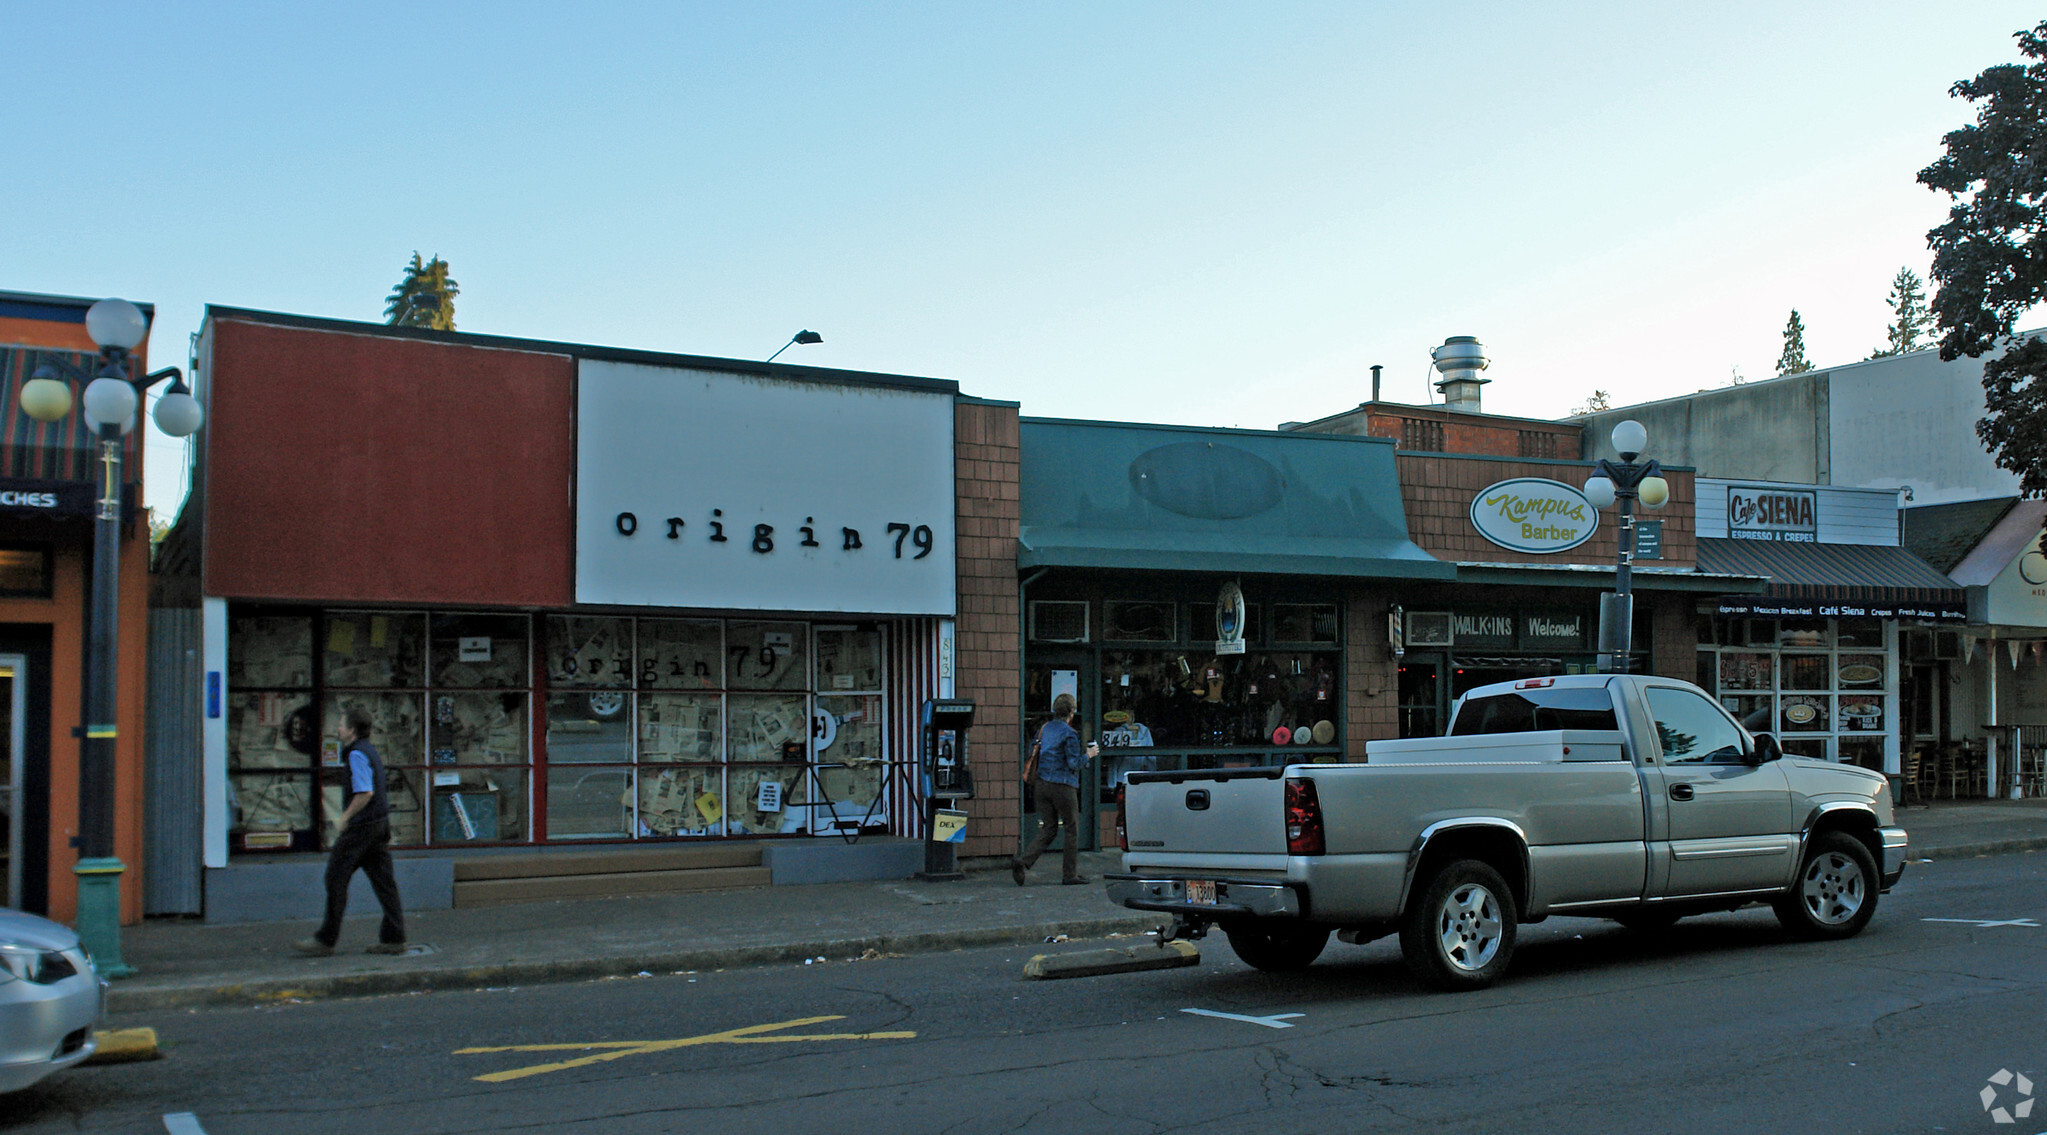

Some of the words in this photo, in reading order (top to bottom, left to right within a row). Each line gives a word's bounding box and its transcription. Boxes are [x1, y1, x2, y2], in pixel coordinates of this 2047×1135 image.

[1486, 494, 1586, 523] Kampus
[1757, 495, 1813, 525] SIENA
[616, 509, 862, 553] origin
[887, 522, 933, 559] 79
[1522, 523, 1578, 540] Barber
[1731, 530, 1773, 540] ESPRESSO
[1775, 532, 1781, 541] &
[1784, 532, 1814, 543] CREPES
[1819, 606, 1839, 615] Café
[1841, 606, 1865, 616] Siena
[1529, 616, 1580, 637] Welcome!
[562, 651, 710, 682] origin
[1102, 734, 1131, 747] 849
